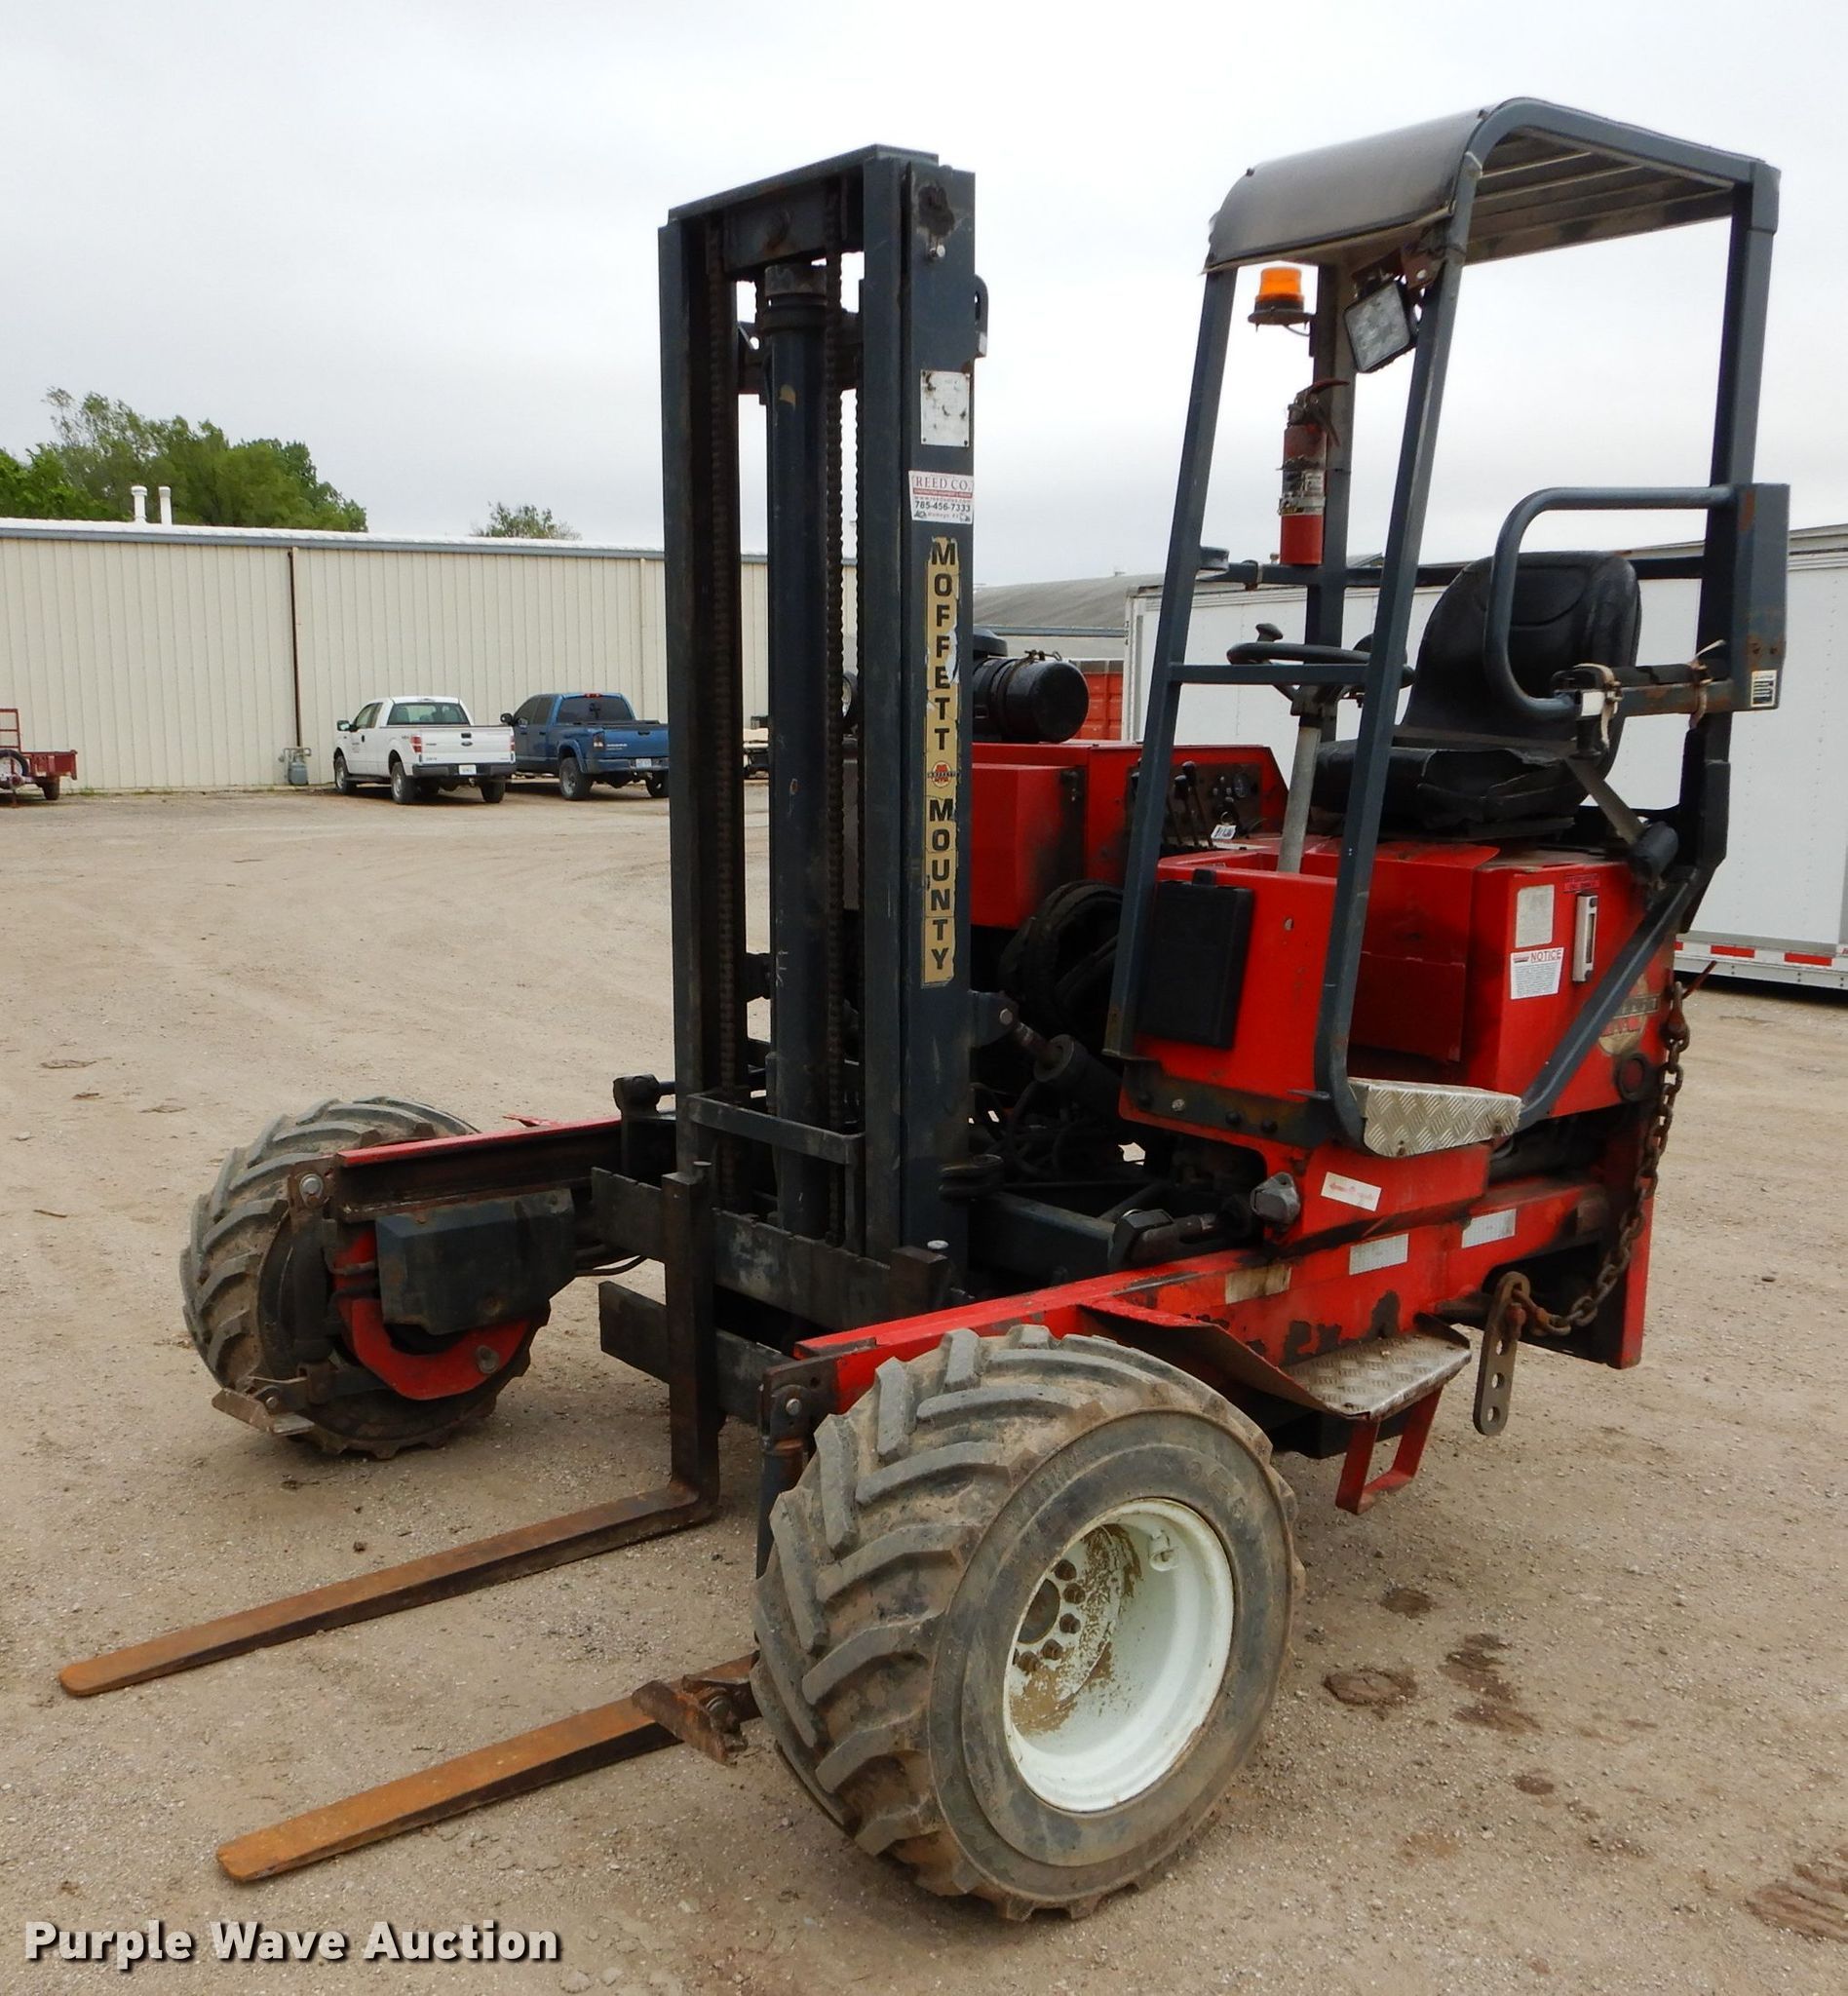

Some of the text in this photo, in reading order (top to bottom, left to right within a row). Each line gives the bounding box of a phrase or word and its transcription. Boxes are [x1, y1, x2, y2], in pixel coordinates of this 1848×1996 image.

[916, 477, 971, 491] REED CO.
[915, 500, 971, 513] 785-456-7333
[931, 542, 955, 750] MOFFETT
[929, 798, 953, 970] MOUNTY
[1531, 949, 1562, 963] NOTICE
